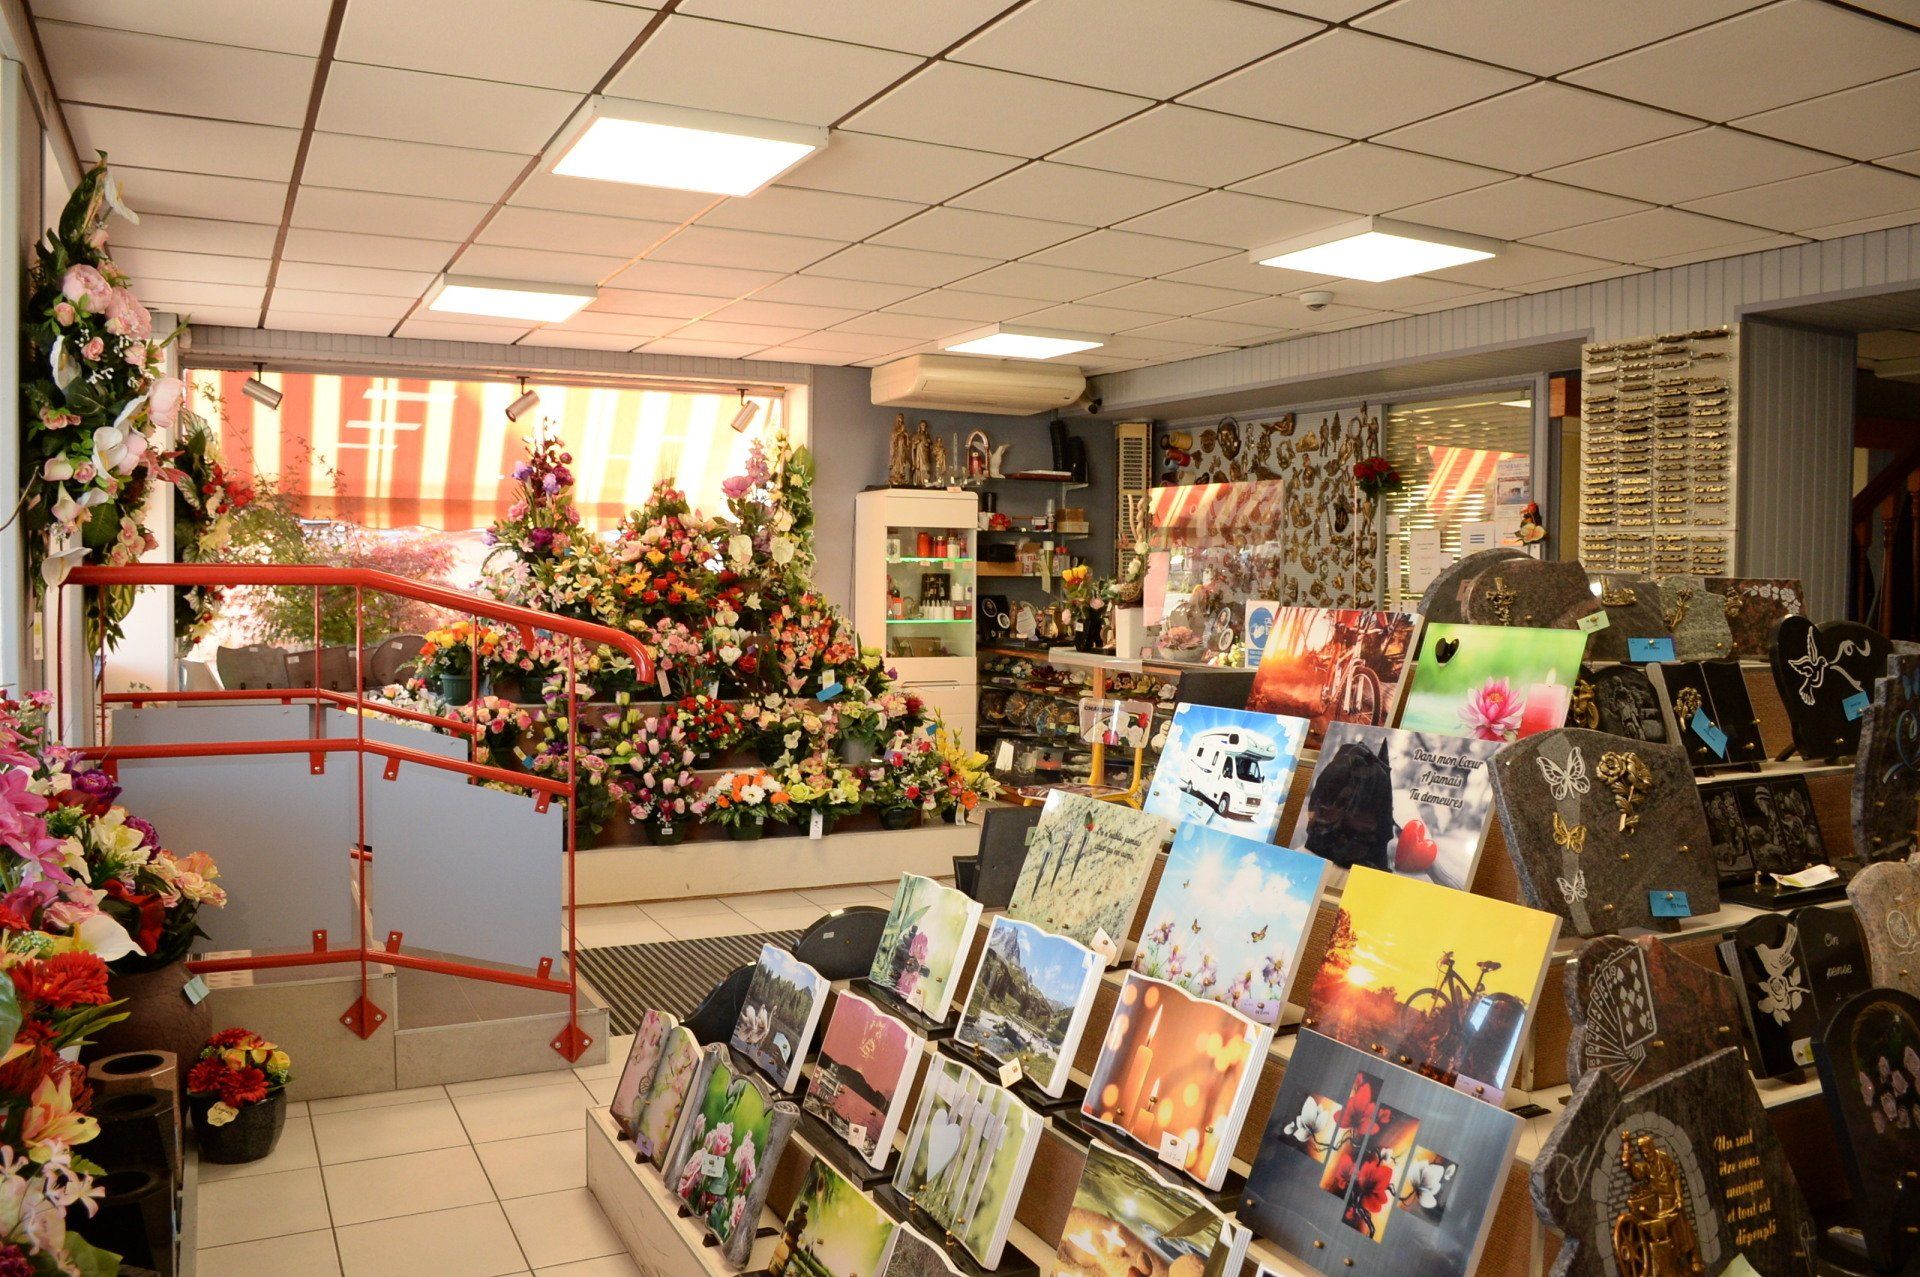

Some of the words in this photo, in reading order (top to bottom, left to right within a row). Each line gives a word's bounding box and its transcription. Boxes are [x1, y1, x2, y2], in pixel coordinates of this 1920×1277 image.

[1414, 748, 1437, 763] Dans
[1437, 755, 1457, 766] mon
[1458, 755, 1483, 769] Cœur
[1421, 770, 1429, 782] A
[1428, 772, 1462, 787] jamais
[1409, 788, 1420, 800] Tu
[1420, 791, 1463, 809] demeures
[1824, 932, 1839, 947] On
[1826, 964, 1853, 979] pense
[1735, 1128, 1753, 1147] seul
[1726, 1179, 1764, 1199] manque
[1727, 1208, 1735, 1223] et
[1738, 1202, 1757, 1220] tout
[1759, 1197, 1771, 1213] est
